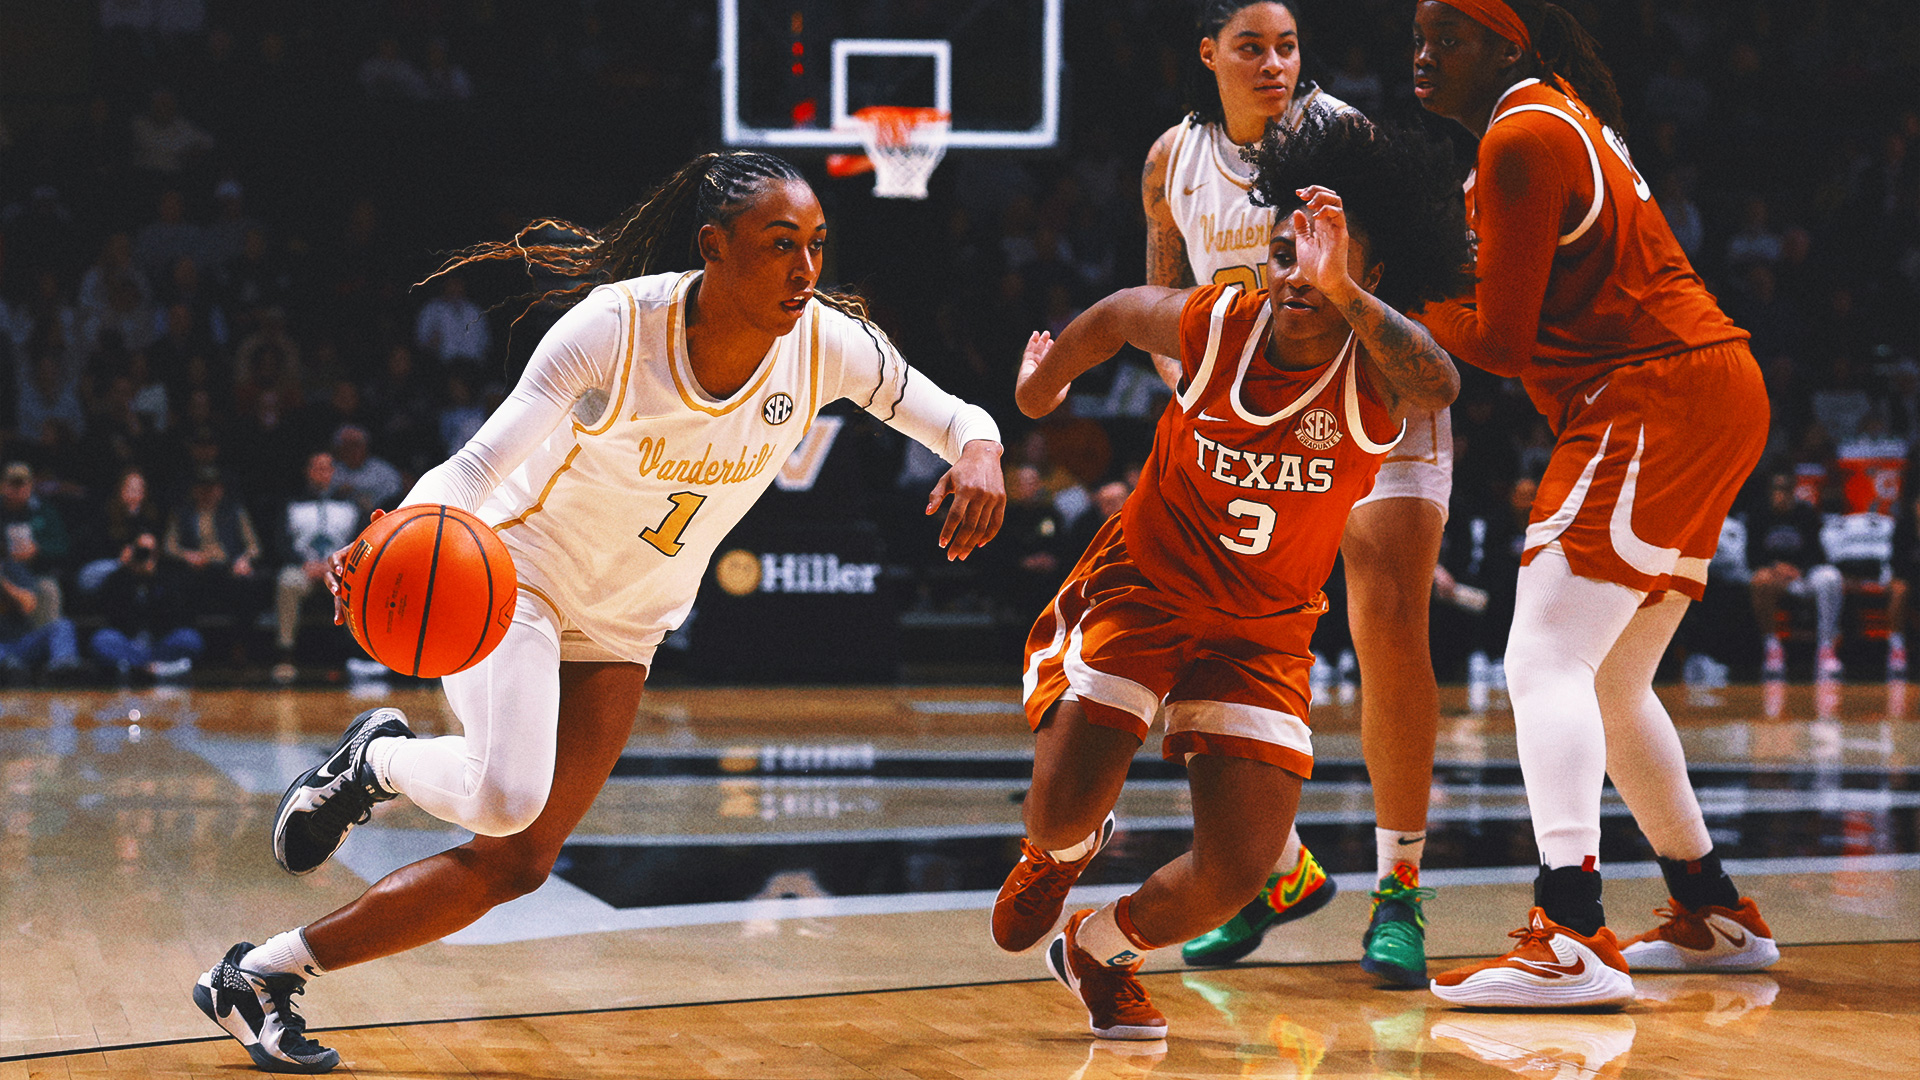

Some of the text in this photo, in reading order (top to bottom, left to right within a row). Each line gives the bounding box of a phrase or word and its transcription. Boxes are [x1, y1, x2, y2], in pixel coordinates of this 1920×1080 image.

[1200, 209, 1273, 254] Vanderb
[763, 394, 793, 425] SEC
[1304, 411, 1334, 440] SEC
[1193, 428, 1336, 493] TEXAS
[1297, 431, 1341, 450] GRADUATE
[638, 491, 708, 557] 1
[1218, 498, 1278, 556] 3
[760, 552, 882, 594] Hiller
